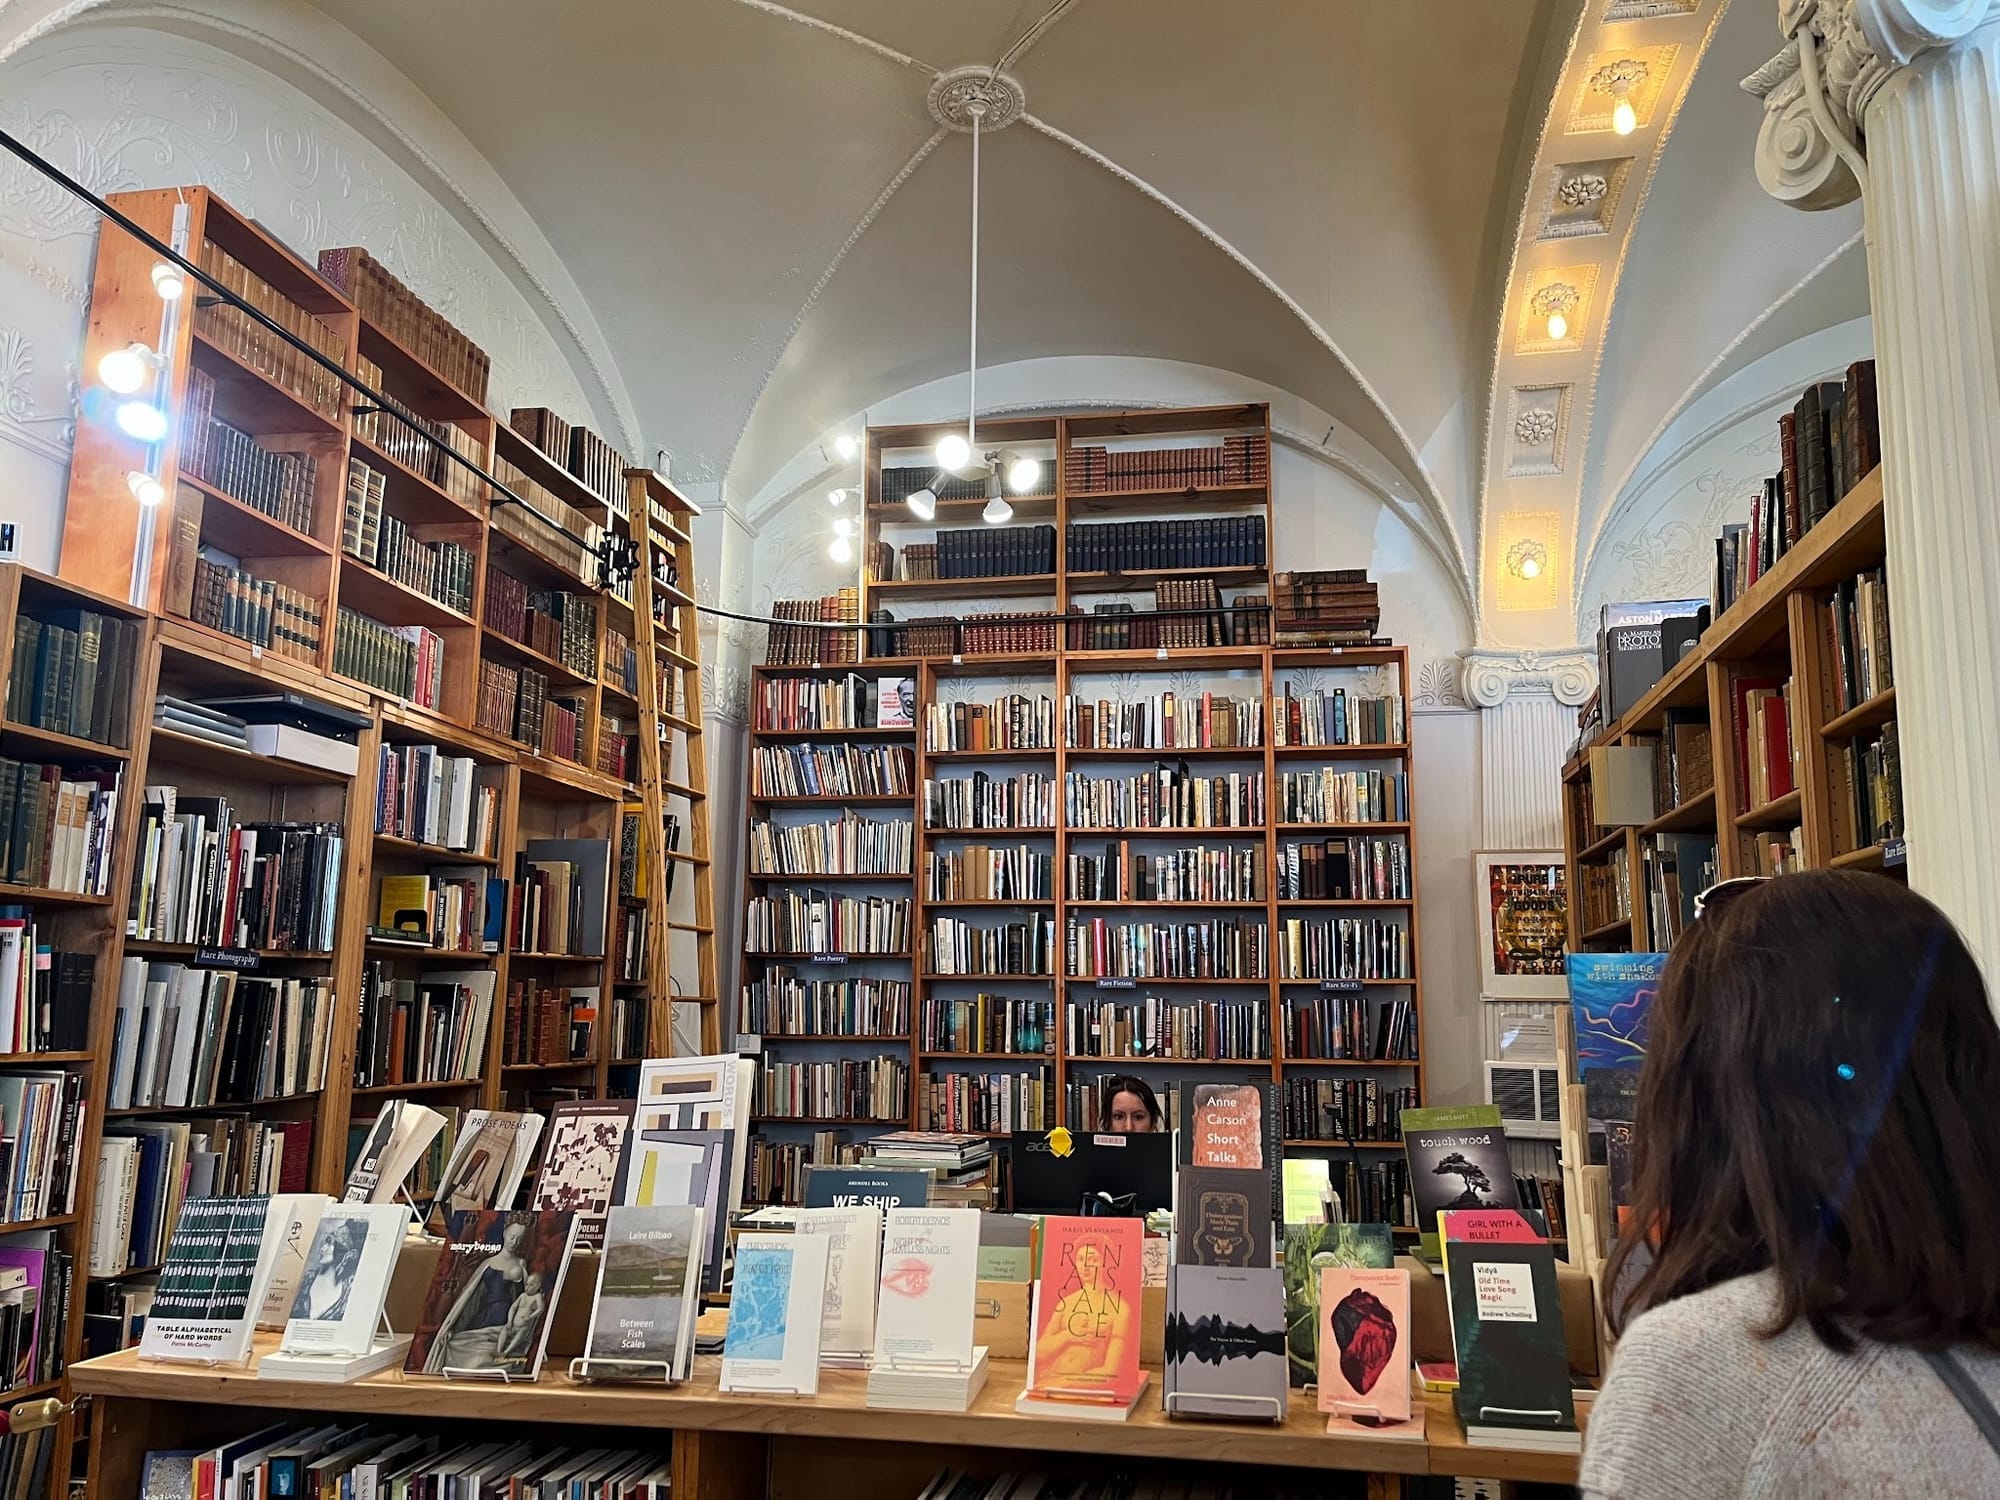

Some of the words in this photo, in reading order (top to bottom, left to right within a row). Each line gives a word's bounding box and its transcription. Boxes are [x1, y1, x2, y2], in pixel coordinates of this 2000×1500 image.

[1618, 614, 1653, 624] ASTON
[1617, 635, 1661, 648] PROTO
[1514, 900, 1555, 911] GOODS
[201, 949, 216, 959] Rare
[217, 950, 257, 966] Photography
[827, 955, 845, 963] Poetry
[1593, 963, 1655, 974] swimming
[1586, 971, 1616, 981] with
[723, 1060, 737, 1117] WORDS
[1206, 1096, 1237, 1107] Anne
[470, 1117, 500, 1129] PROSE
[500, 1119, 528, 1131] POEMS
[1206, 1114, 1247, 1126] Carson
[1206, 1133, 1240, 1144] Short
[1420, 1136, 1456, 1149] touch
[1459, 1134, 1492, 1145] wood
[1025, 1141, 1051, 1152] ace
[1206, 1152, 1237, 1163] Talks
[832, 1194, 859, 1208] WE
[862, 1194, 901, 1210] SHIP
[577, 1224, 600, 1233] POEMS
[1467, 1219, 1489, 1229] GIRL
[1490, 1219, 1512, 1228] WITH
[1513, 1218, 1523, 1228] A
[628, 1231, 648, 1240] Leire
[648, 1230, 673, 1240] Bilbao
[1468, 1230, 1501, 1239] BULLET
[1060, 1243, 1122, 1268] REN
[1063, 1266, 1117, 1291] AIS
[1493, 1277, 1511, 1285] Time
[1497, 1285, 1517, 1295] Song
[1055, 1289, 1122, 1315] SAN
[1480, 1293, 1503, 1302] Magic
[1504, 1311, 1532, 1319] Schelling
[619, 1318, 654, 1329] Between
[1068, 1311, 1109, 1339] CE
[627, 1329, 644, 1338] Fish
[621, 1339, 647, 1349] Scales
